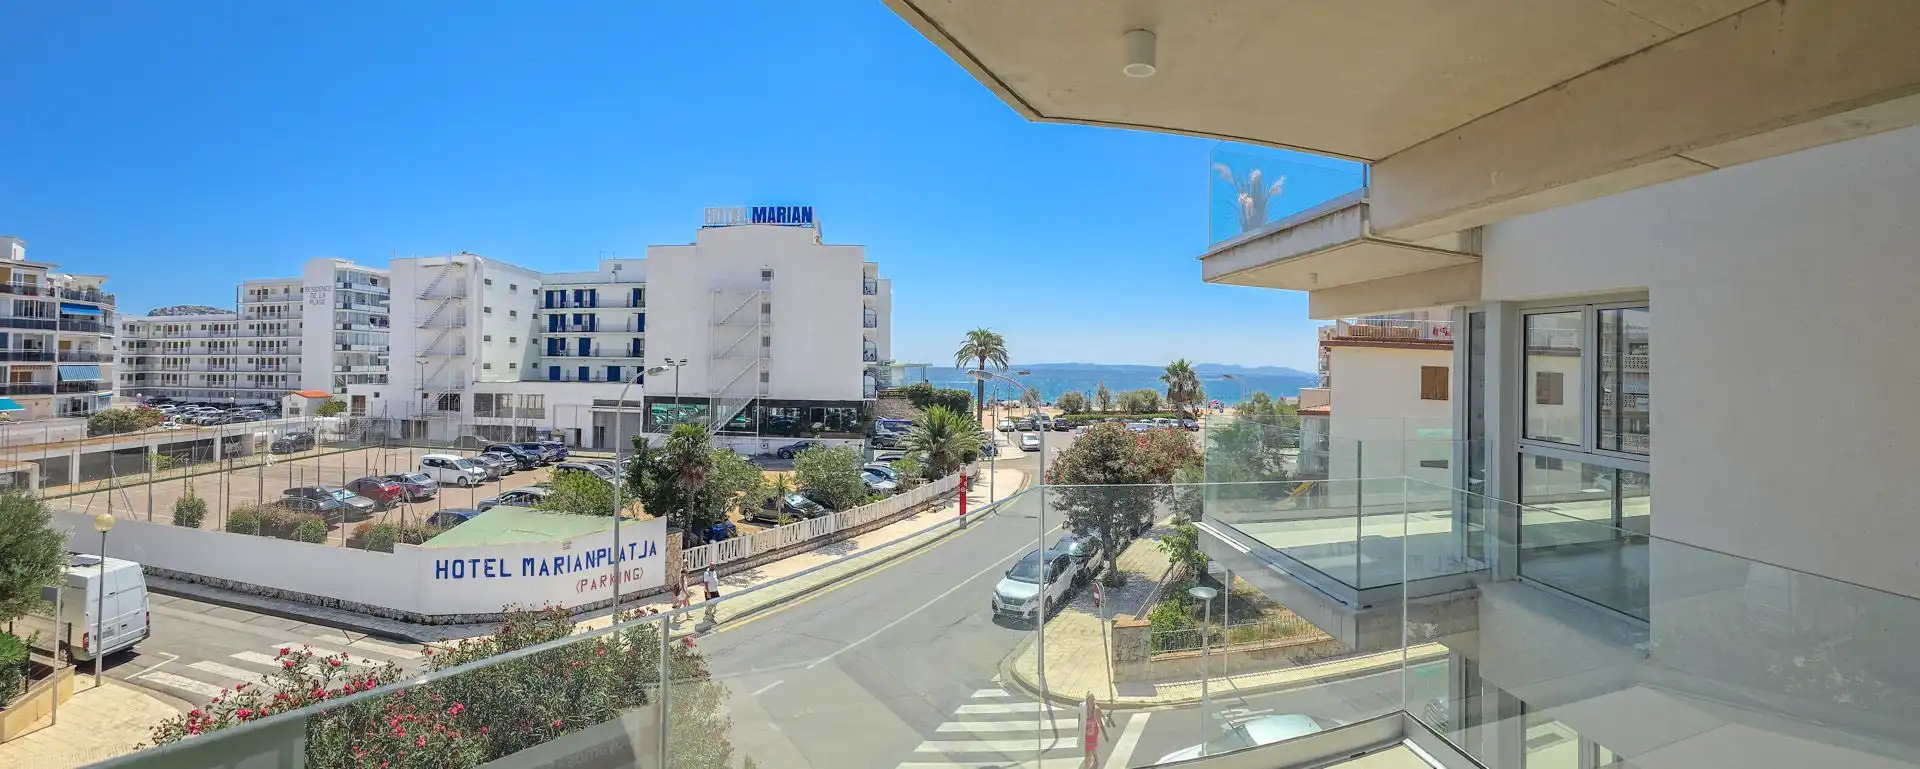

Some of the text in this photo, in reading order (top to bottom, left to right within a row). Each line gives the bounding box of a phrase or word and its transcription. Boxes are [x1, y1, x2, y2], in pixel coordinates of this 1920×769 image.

[704, 206, 813, 225] HOTEL MARIAN
[435, 558, 512, 580] HOTEL
